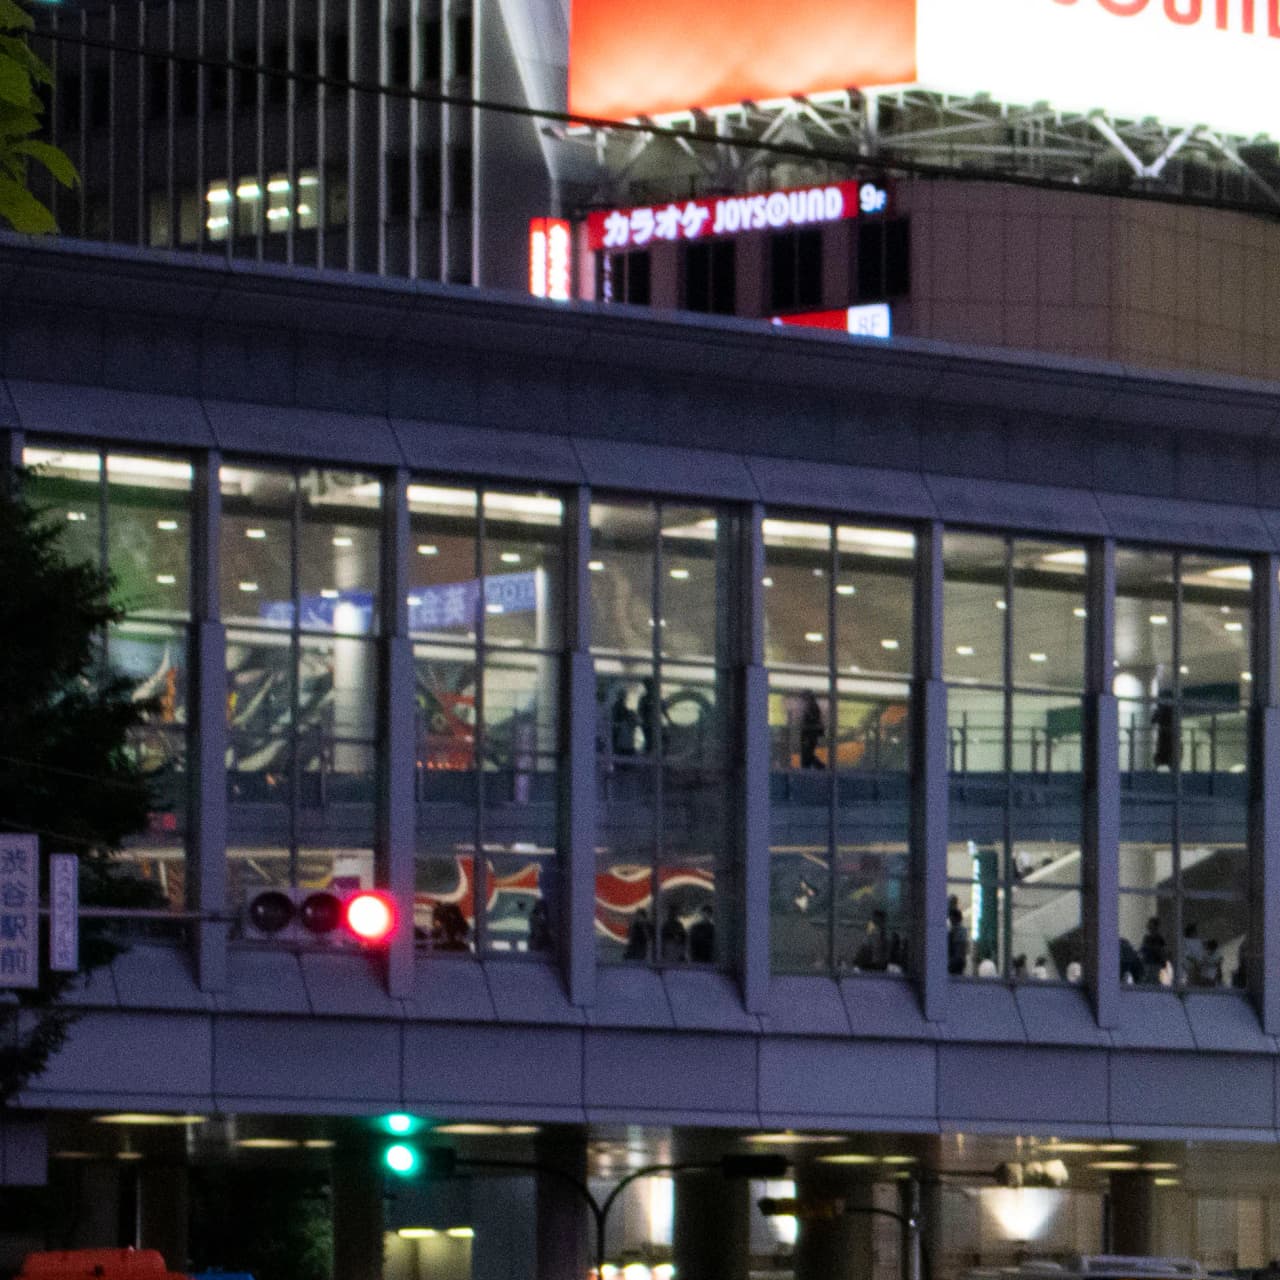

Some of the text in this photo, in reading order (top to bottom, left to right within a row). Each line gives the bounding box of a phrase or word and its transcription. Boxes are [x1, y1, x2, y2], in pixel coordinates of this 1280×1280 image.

[603, 183, 886, 247] カラオケ JOYSOUND 9F
